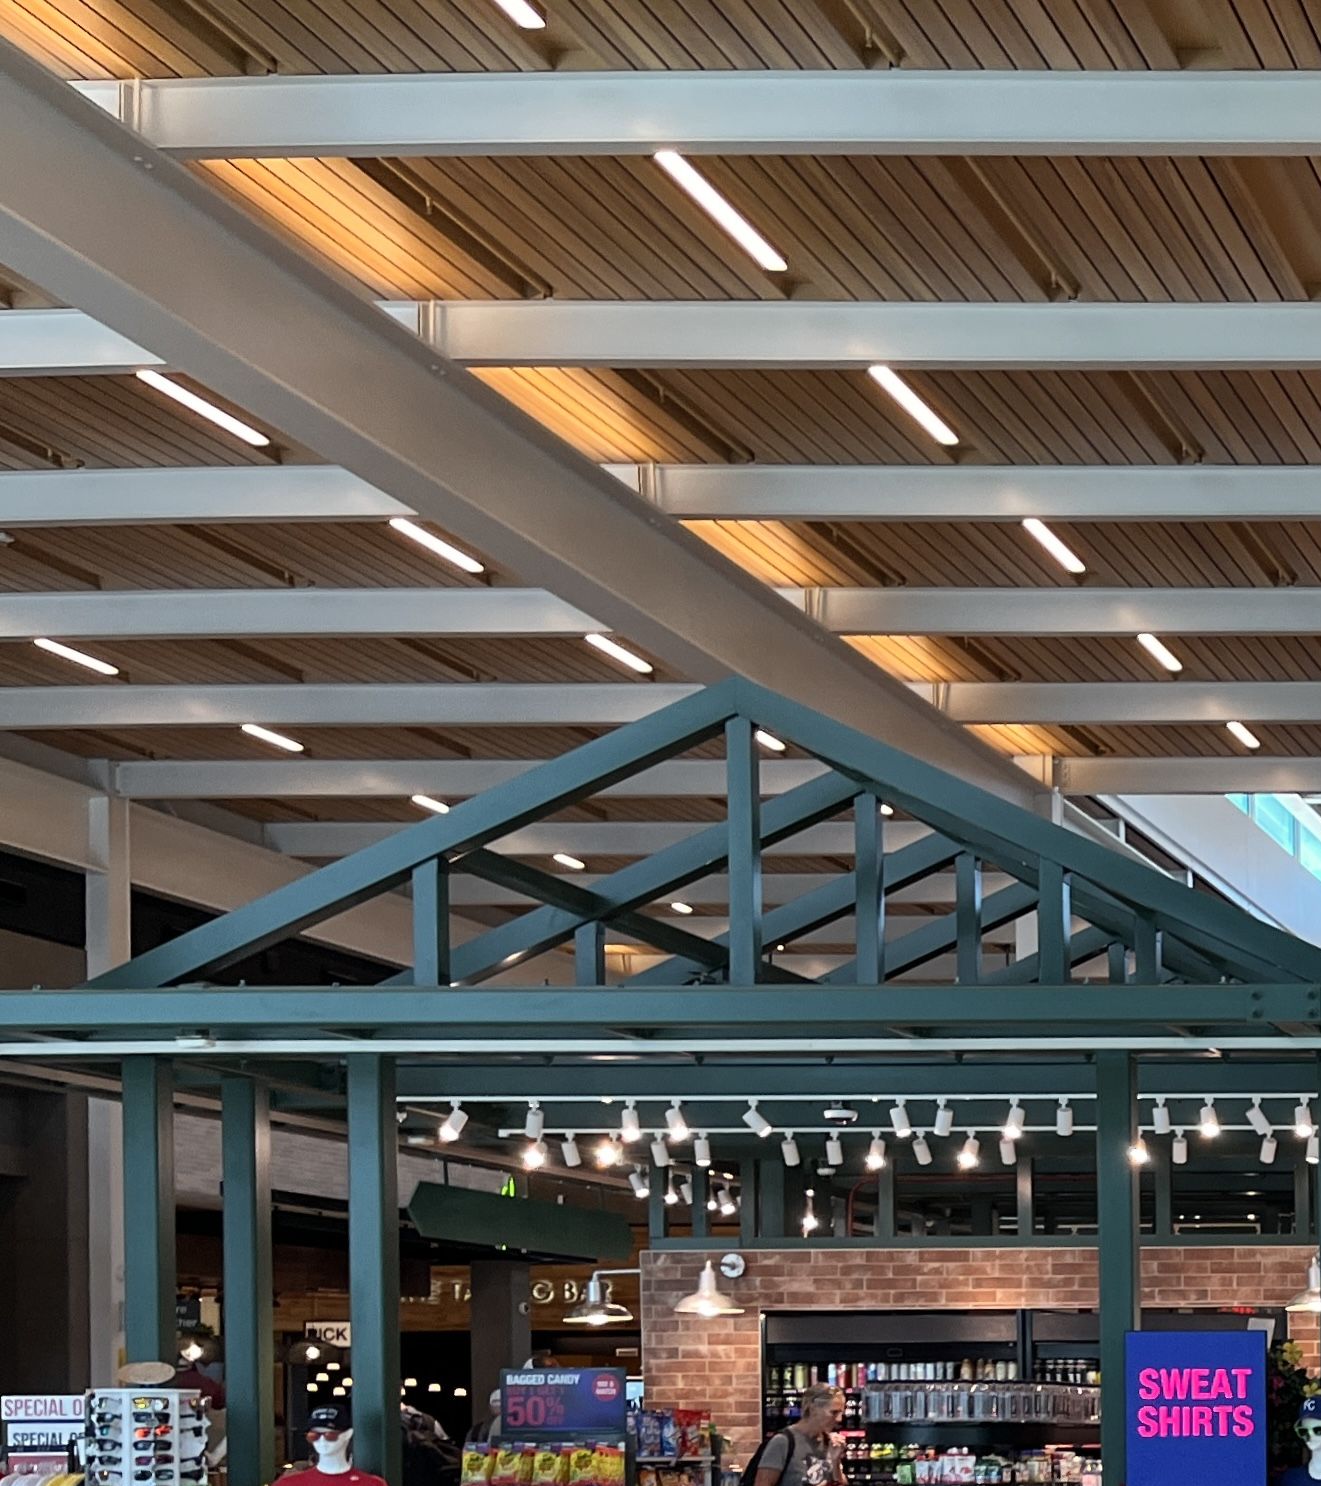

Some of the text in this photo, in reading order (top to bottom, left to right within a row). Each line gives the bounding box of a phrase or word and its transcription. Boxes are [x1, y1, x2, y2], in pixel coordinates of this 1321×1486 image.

[547, 1373, 580, 1384] CANDY
[1138, 1367, 1252, 1401] SWEAT
[4, 1398, 68, 1417] SPECIAL
[506, 1396, 564, 1427] 50%
[1137, 1404, 1255, 1438] SHIRTS
